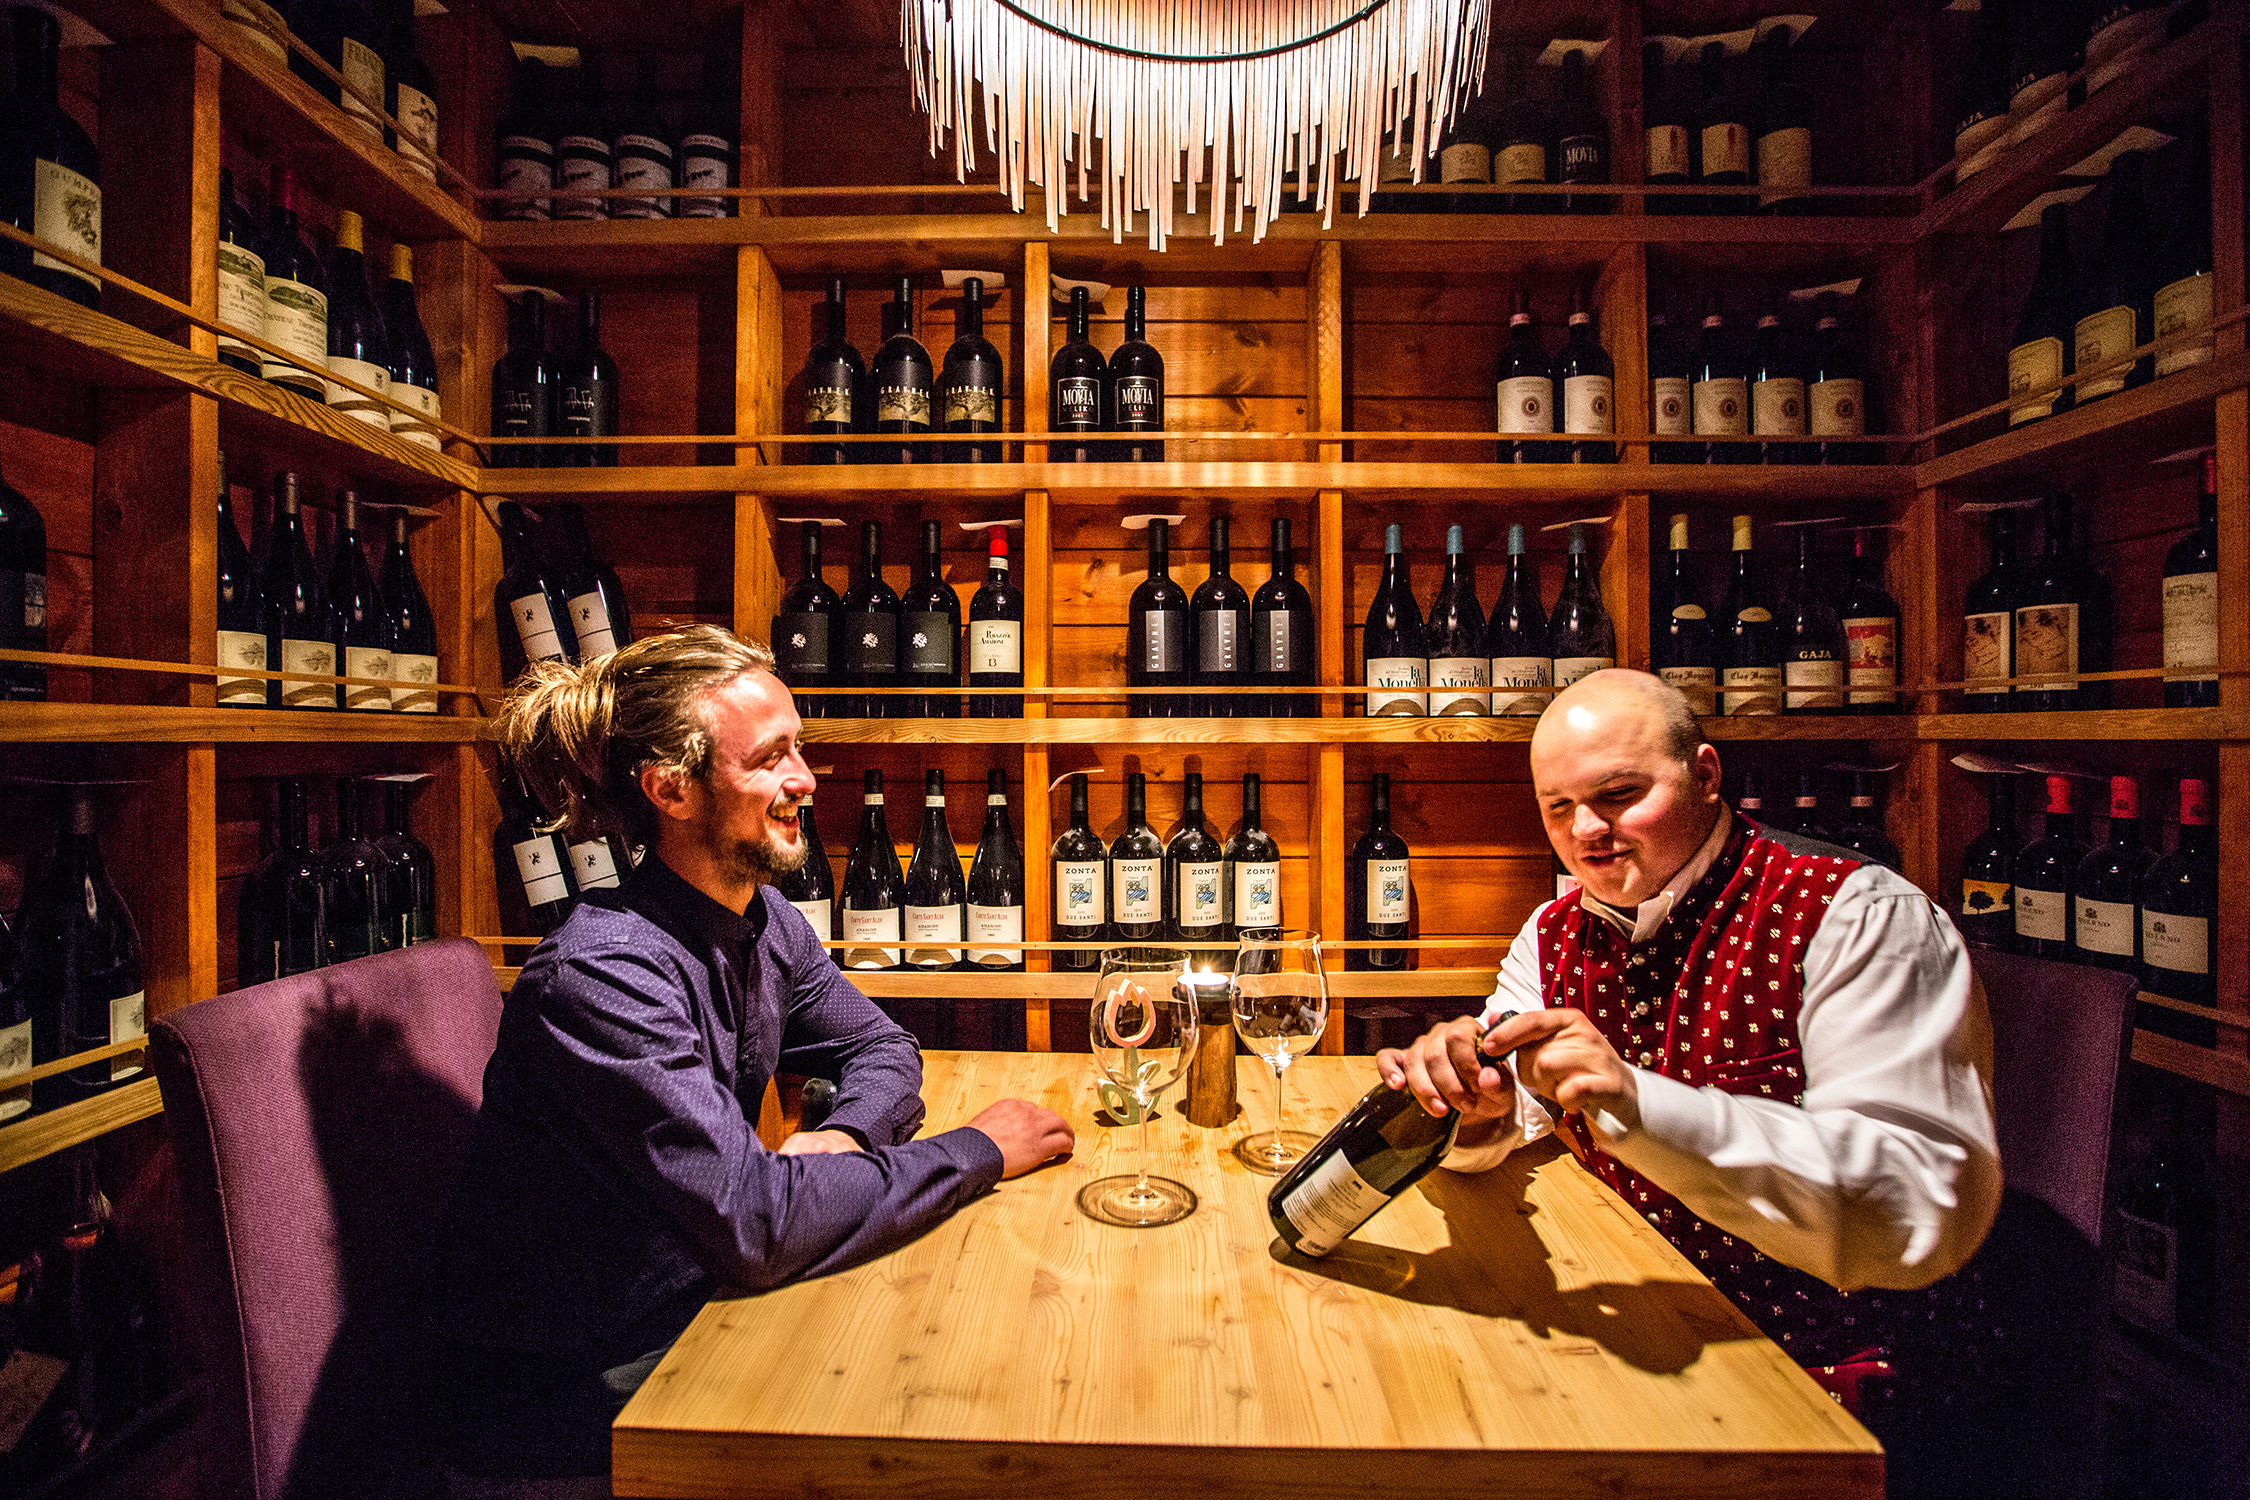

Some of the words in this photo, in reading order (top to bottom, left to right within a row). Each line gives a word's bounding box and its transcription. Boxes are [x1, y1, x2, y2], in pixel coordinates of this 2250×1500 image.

[1063, 388, 1094, 405] MOVIA
[1122, 388, 1153, 405] MOVIA
[1799, 650, 1832, 660] GAJA
[1410, 665, 1420, 680] la
[1473, 665, 1483, 680] la
[1537, 665, 1546, 679] la
